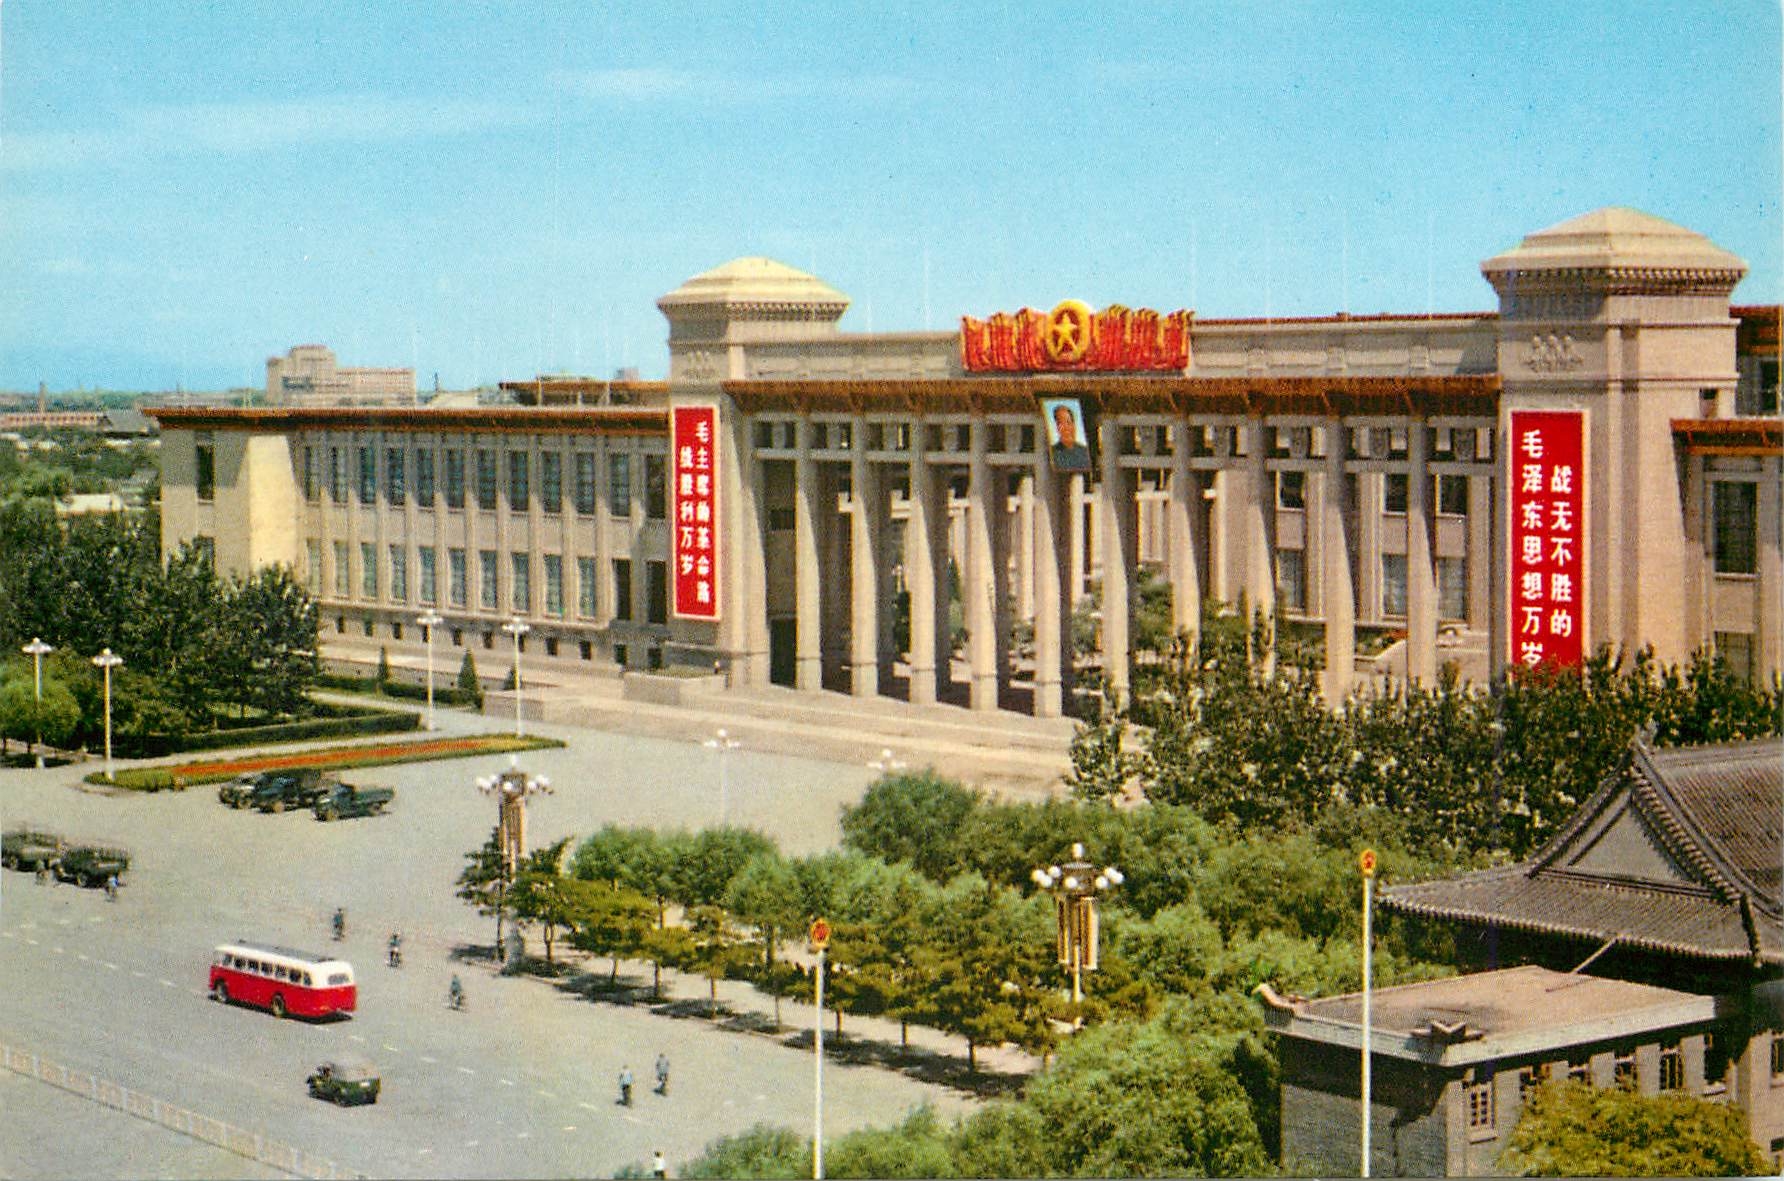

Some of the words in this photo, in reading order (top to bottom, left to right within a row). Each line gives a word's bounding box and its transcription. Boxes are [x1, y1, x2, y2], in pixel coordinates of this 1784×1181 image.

[1550, 464, 1572, 637] 战无不胜的
